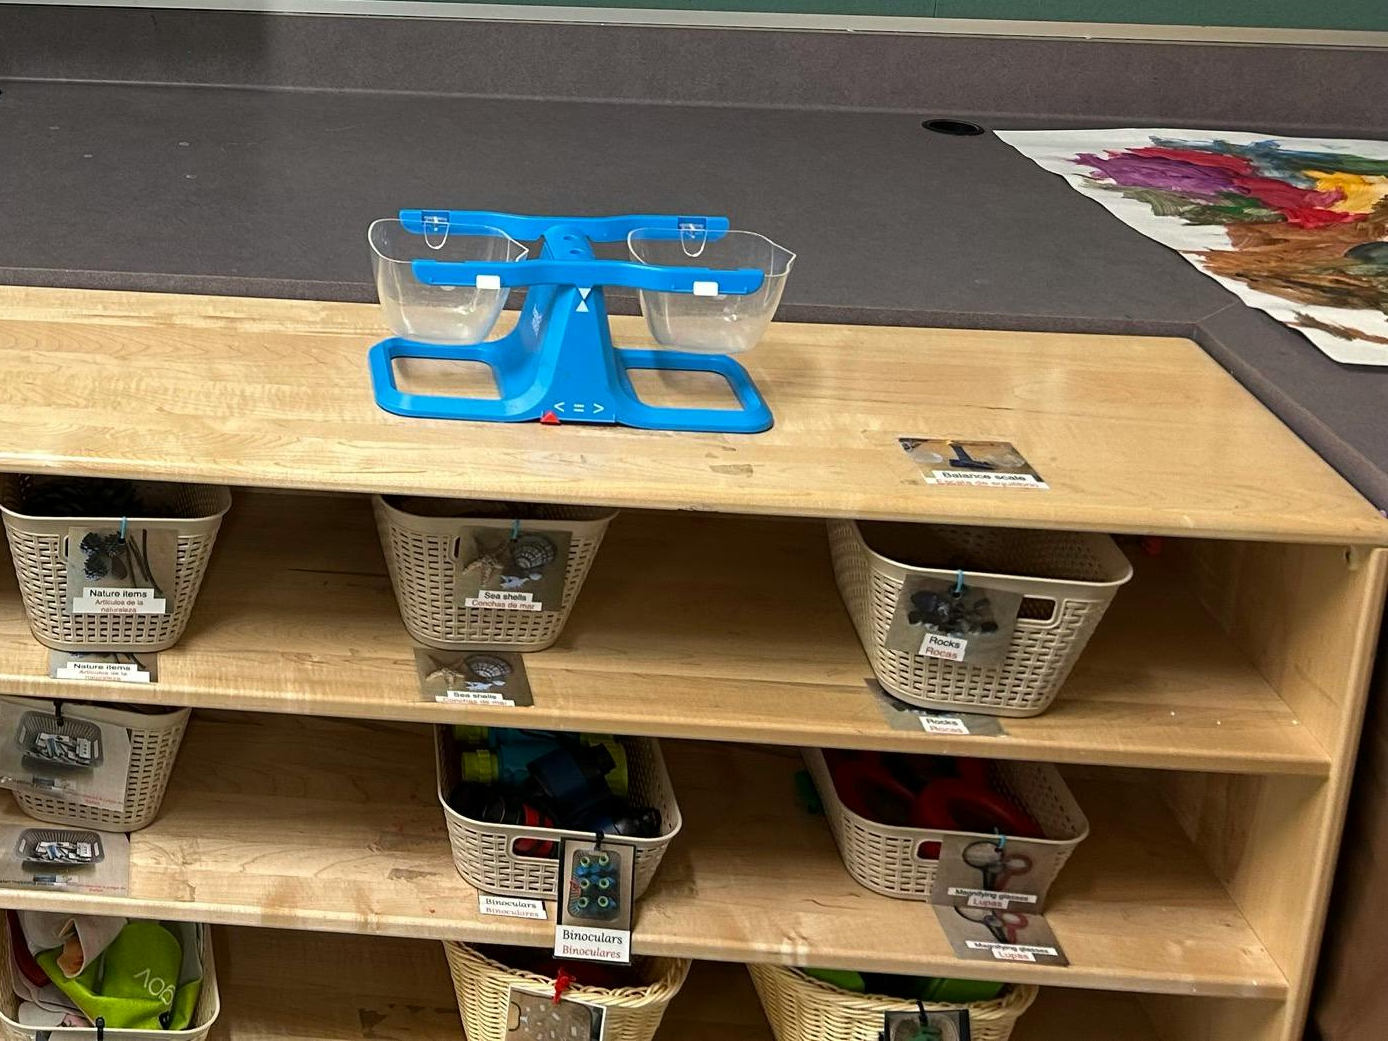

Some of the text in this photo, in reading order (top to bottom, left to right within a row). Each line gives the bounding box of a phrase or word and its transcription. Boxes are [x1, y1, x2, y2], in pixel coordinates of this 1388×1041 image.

[995, 472, 1028, 480] scale
[472, 600, 505, 608] Conchas
[929, 636, 960, 649] Rocks
[925, 647, 957, 660] Rocas
[486, 899, 536, 908] Binoculars
[973, 898, 1002, 907] Lupas
[563, 929, 622, 944] Binoculars
[562, 946, 621, 959] Binoculares
